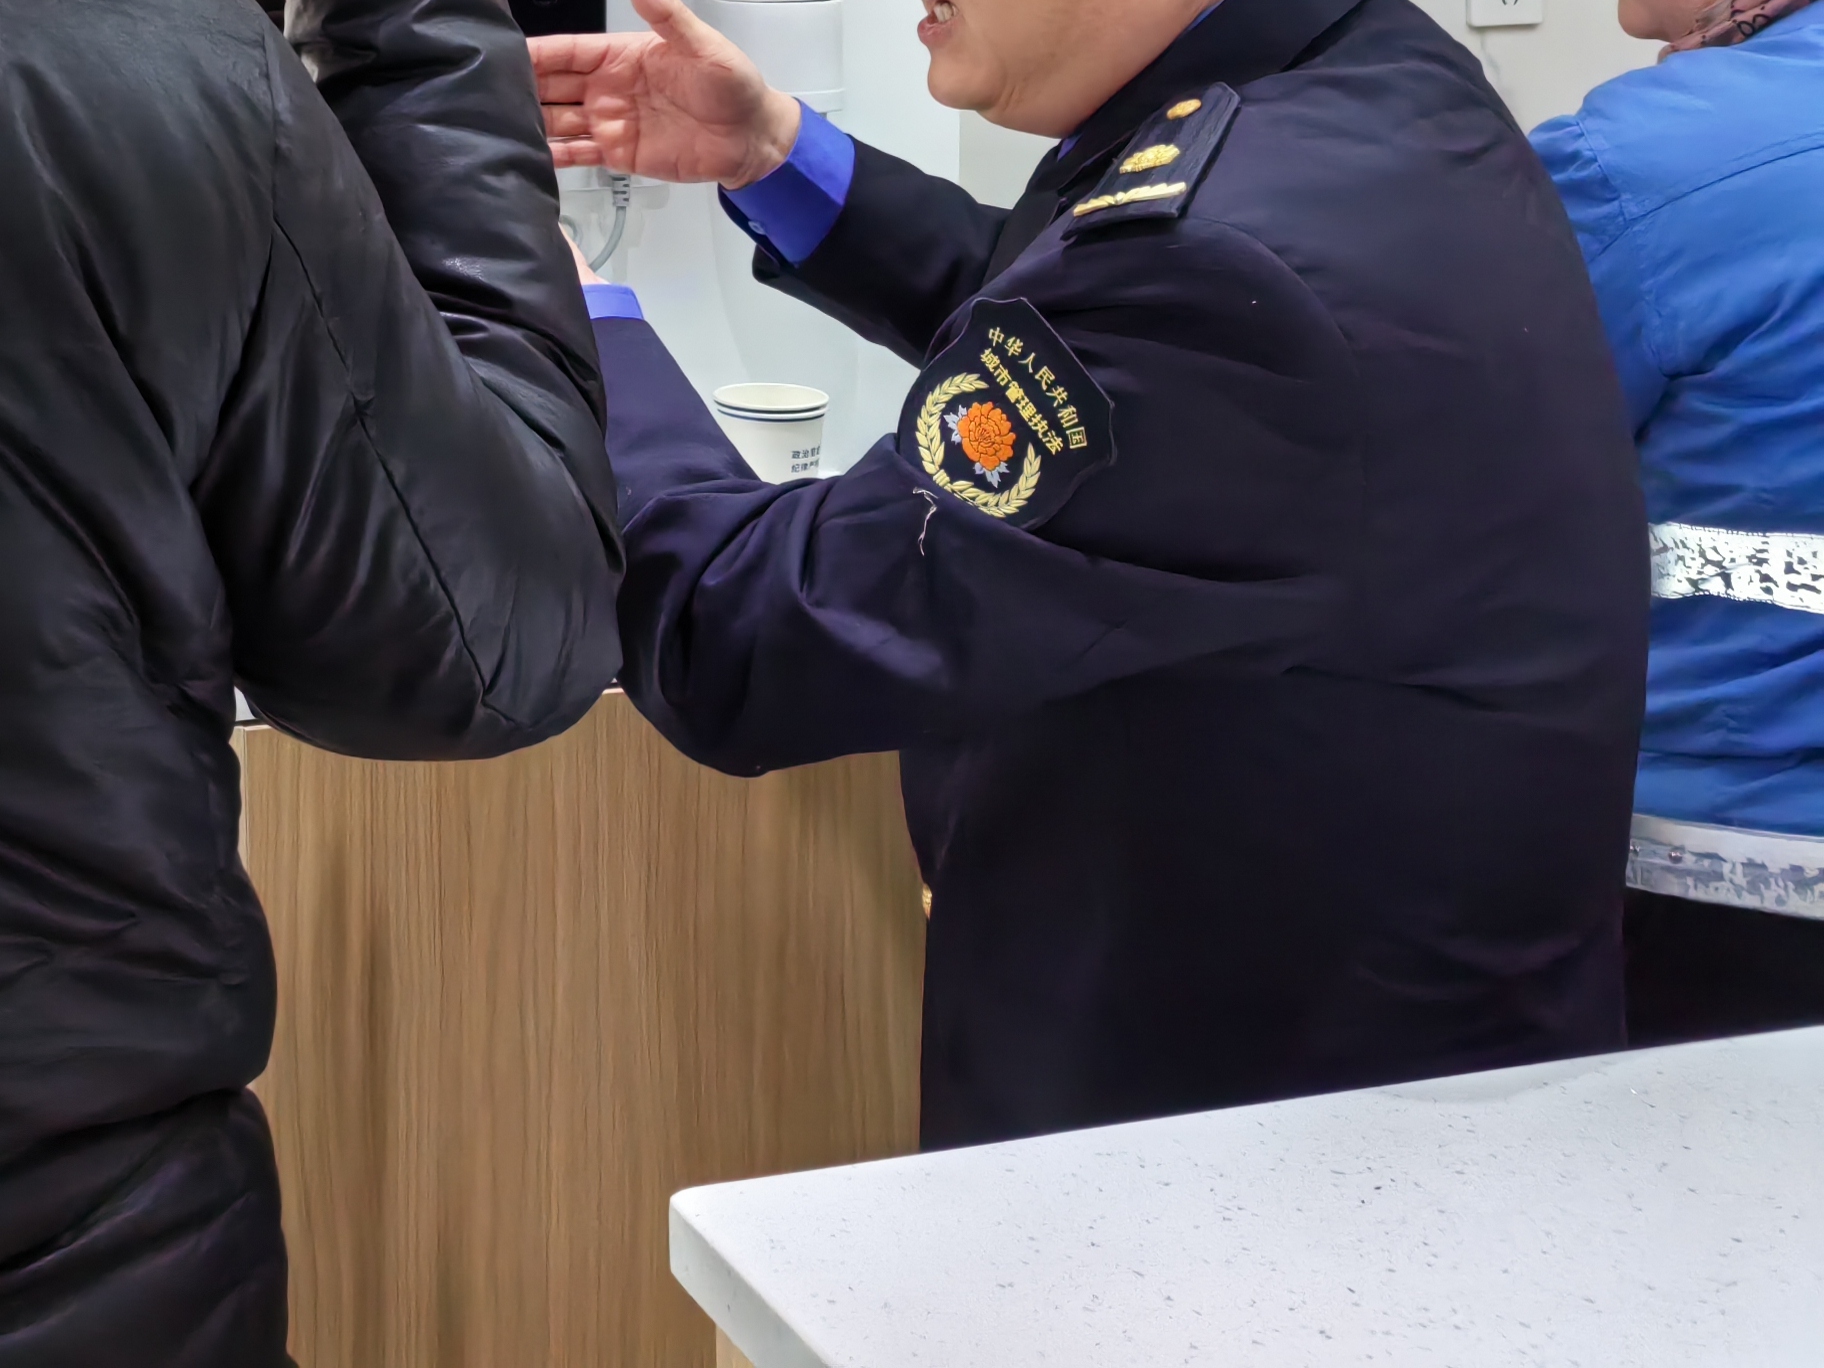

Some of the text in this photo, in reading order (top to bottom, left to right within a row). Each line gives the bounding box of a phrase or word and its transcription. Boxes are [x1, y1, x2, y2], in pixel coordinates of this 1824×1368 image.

[980, 347, 1064, 456] 城市管理执法
[988, 326, 1088, 450] 中华人民共和国
